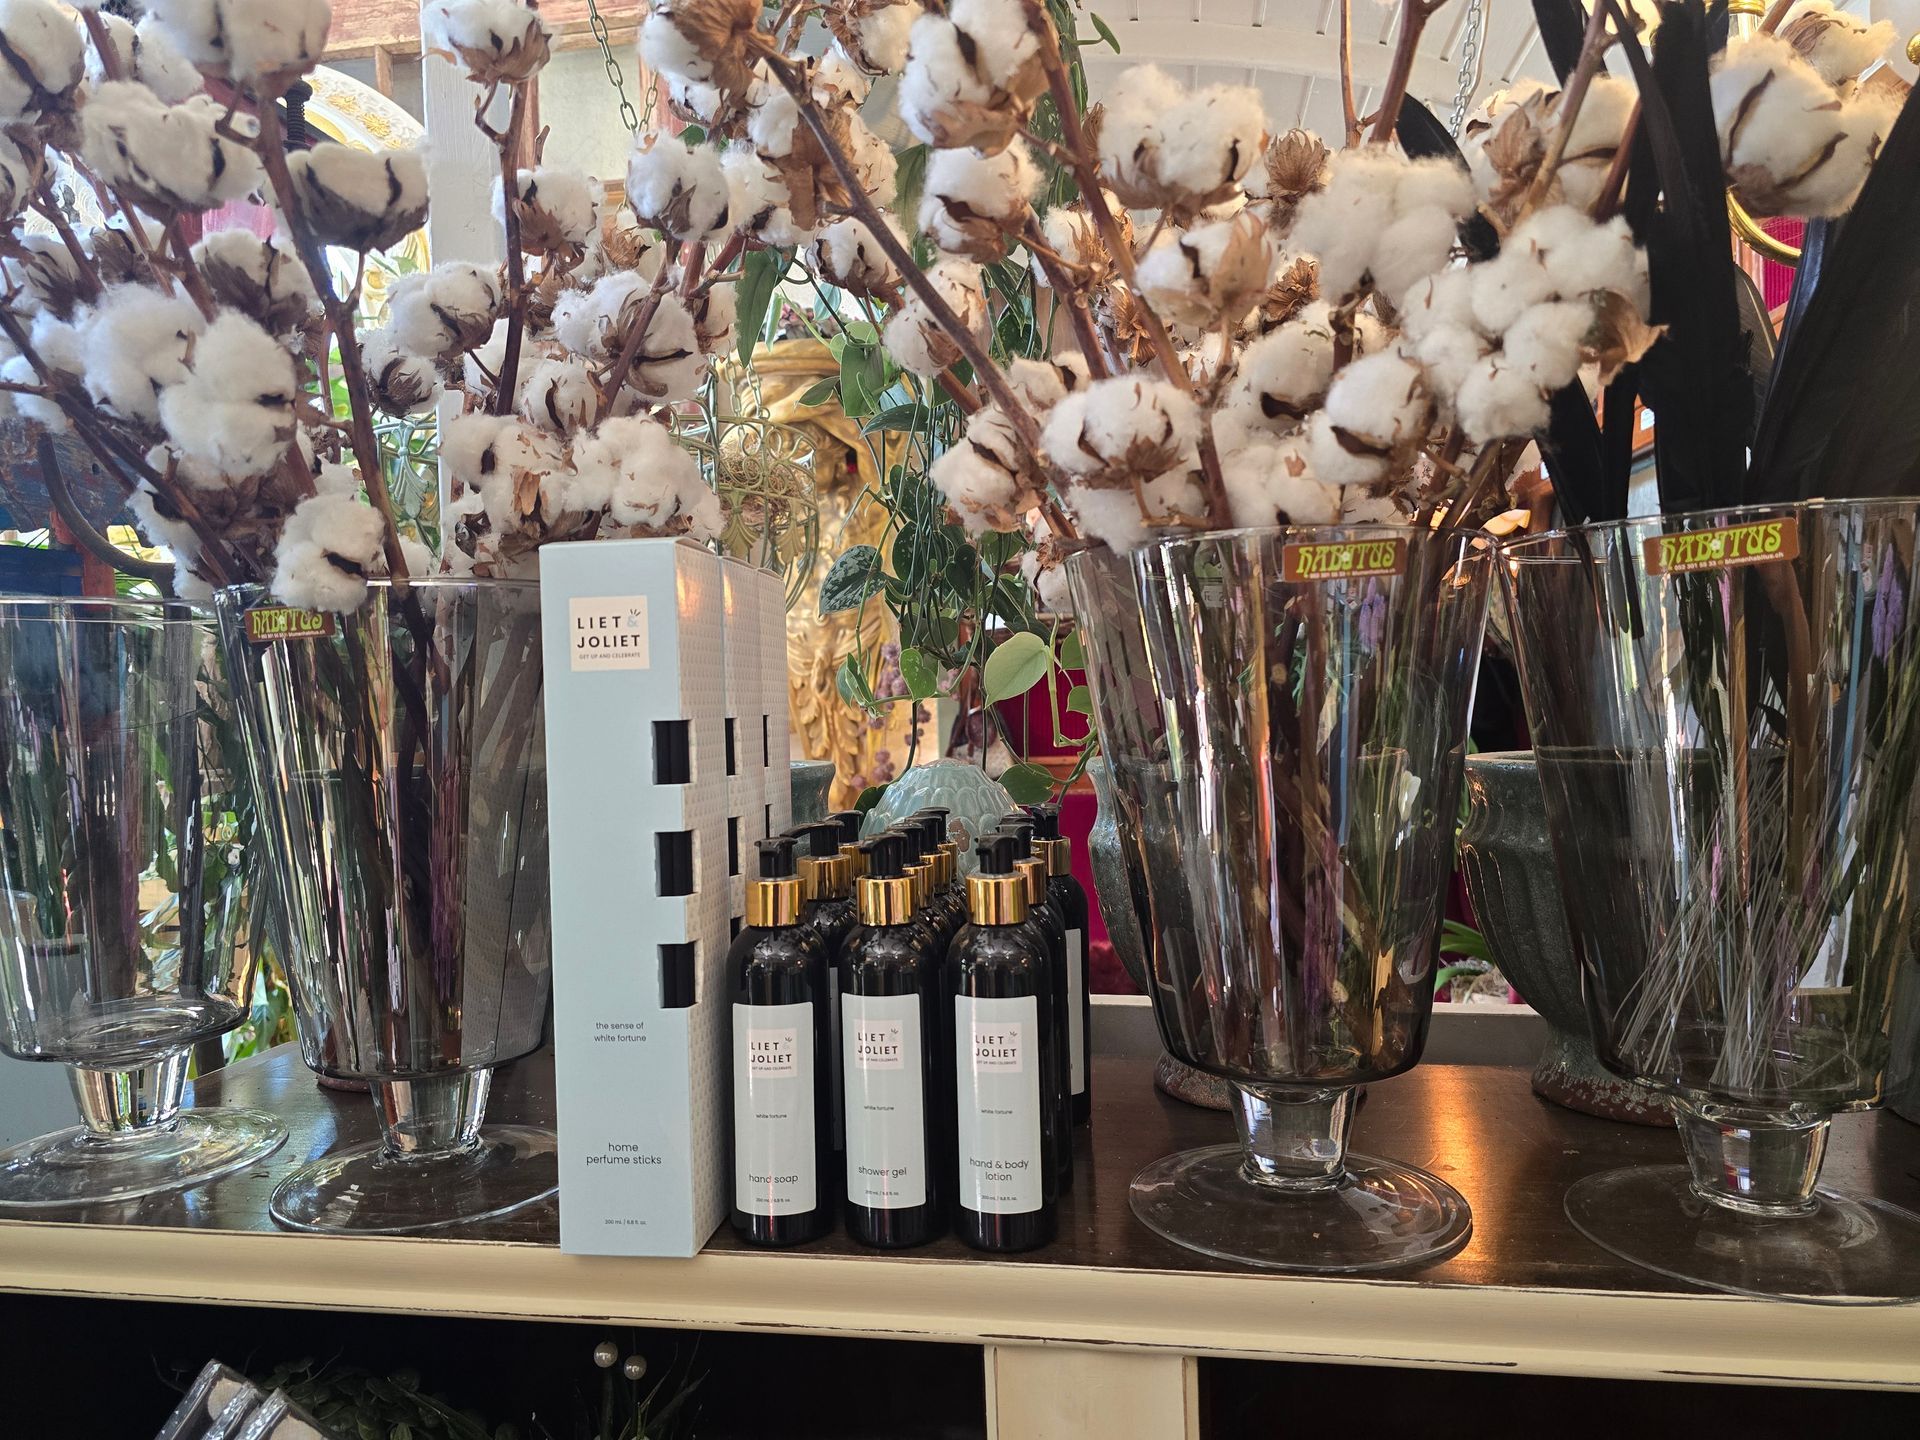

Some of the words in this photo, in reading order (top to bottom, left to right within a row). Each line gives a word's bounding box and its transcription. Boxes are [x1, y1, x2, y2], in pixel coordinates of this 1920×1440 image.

[577, 615, 621, 630] LIET
[577, 634, 640, 649] JOLIET
[611, 651, 640, 659] CELEBRATE
[595, 1021, 609, 1030] the
[635, 1021, 644, 1030] of
[593, 1034, 616, 1042] white
[617, 1034, 647, 1042] fortune
[857, 1032, 885, 1042] LIET
[975, 1035, 1004, 1045] LIET
[751, 1042, 779, 1051] LIET
[857, 1045, 898, 1055] JOLIET
[976, 1048, 1017, 1058] JOLIET
[751, 1054, 792, 1063] JOLIET
[608, 1142, 639, 1152] home
[586, 1154, 631, 1166] perfume
[632, 1155, 662, 1165] sticks
[969, 1156, 993, 1169] hand
[995, 1160, 1003, 1169] &
[1004, 1160, 1029, 1170] body
[858, 1165, 890, 1176] shower
[891, 1167, 907, 1179] gel
[985, 1171, 1012, 1181] lotion
[749, 1173, 772, 1184] hand
[773, 1175, 799, 1185] soap
